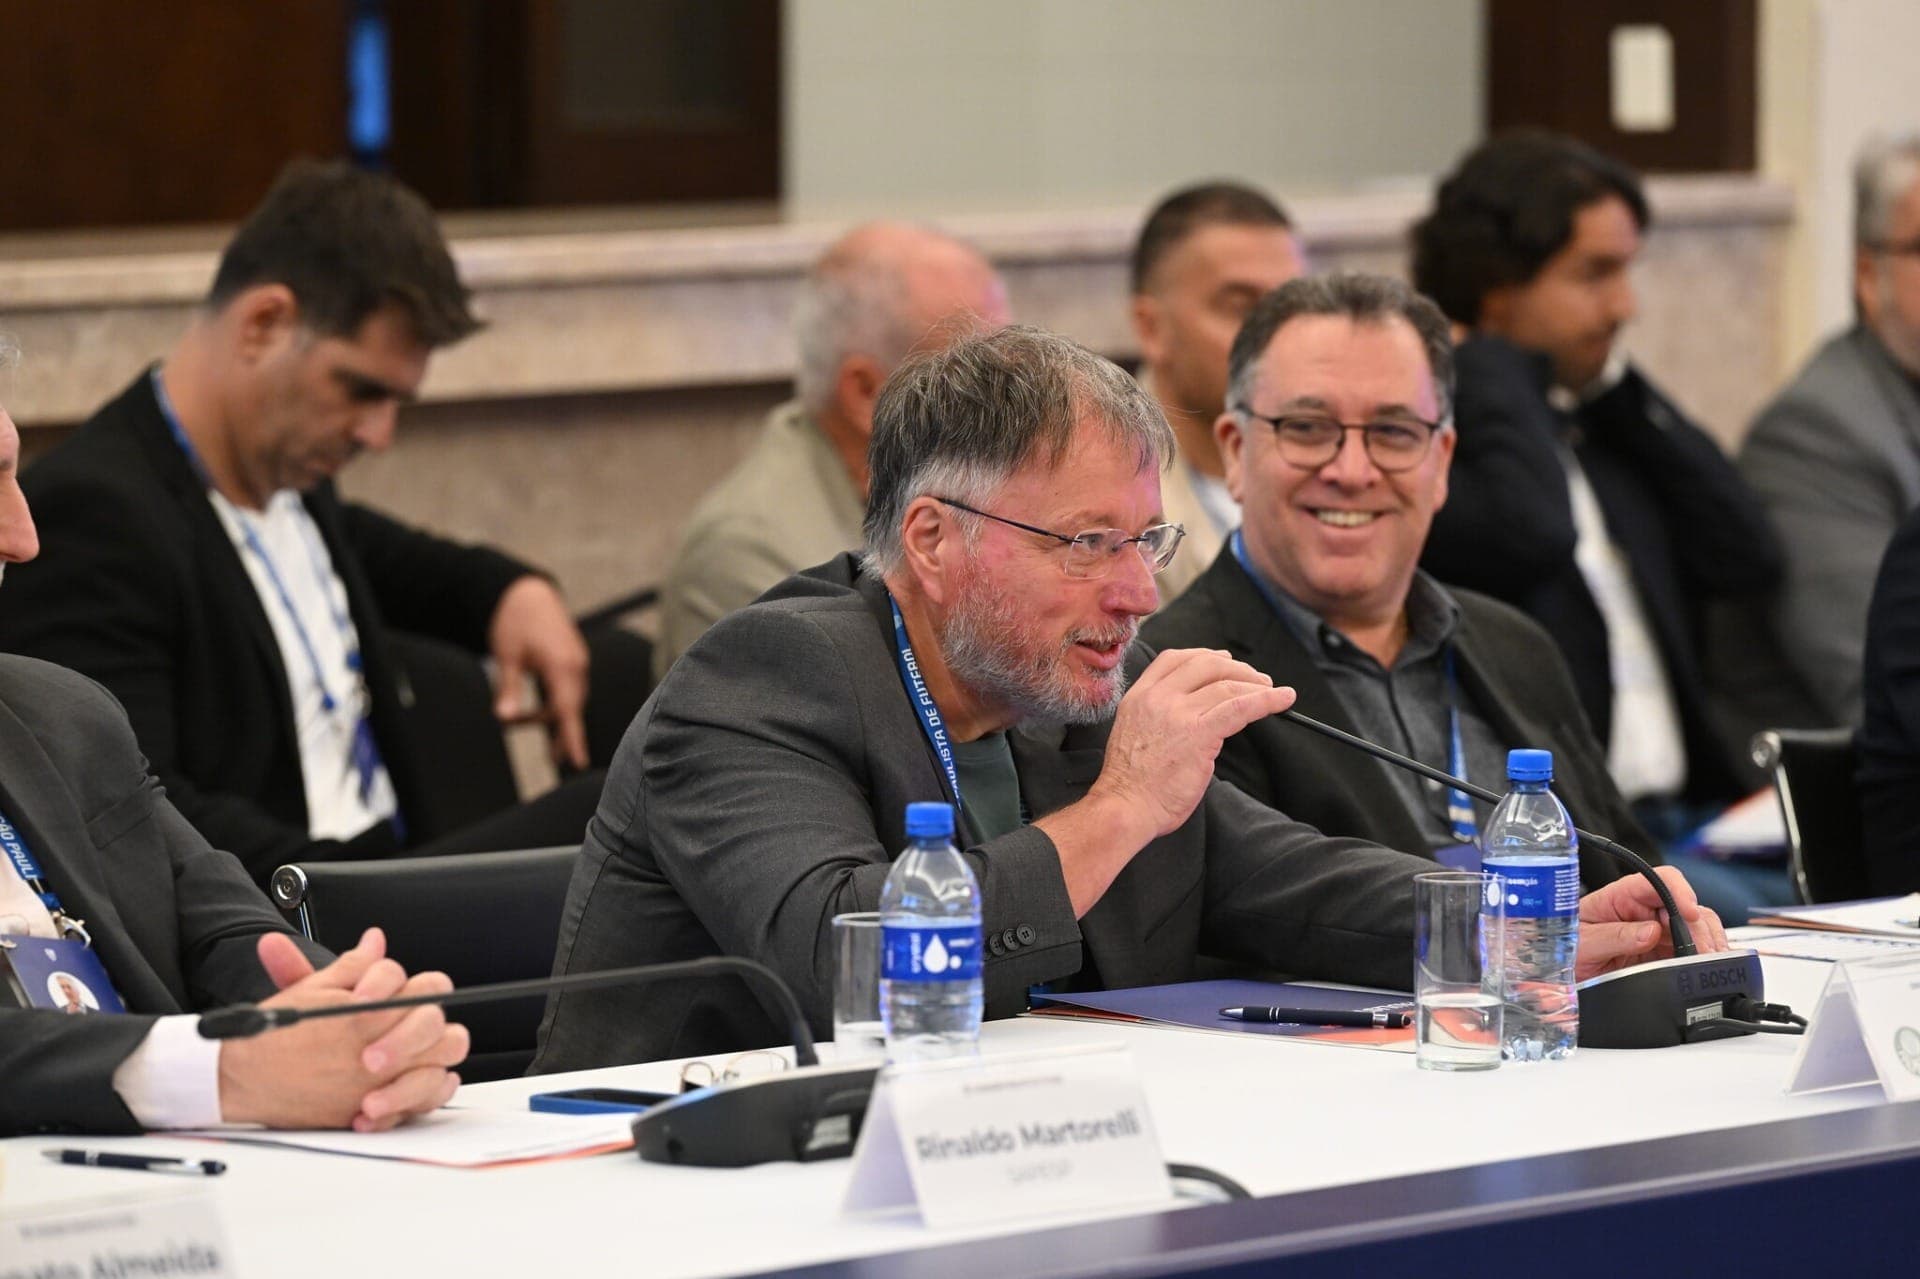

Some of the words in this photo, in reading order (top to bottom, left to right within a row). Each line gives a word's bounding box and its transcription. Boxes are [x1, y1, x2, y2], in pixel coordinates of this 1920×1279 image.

[925, 708, 941, 727] DE
[1699, 967, 1747, 990] BOSCH
[915, 1125, 1016, 1161] Rinaldo
[1019, 1108, 1141, 1147] Martorelli
